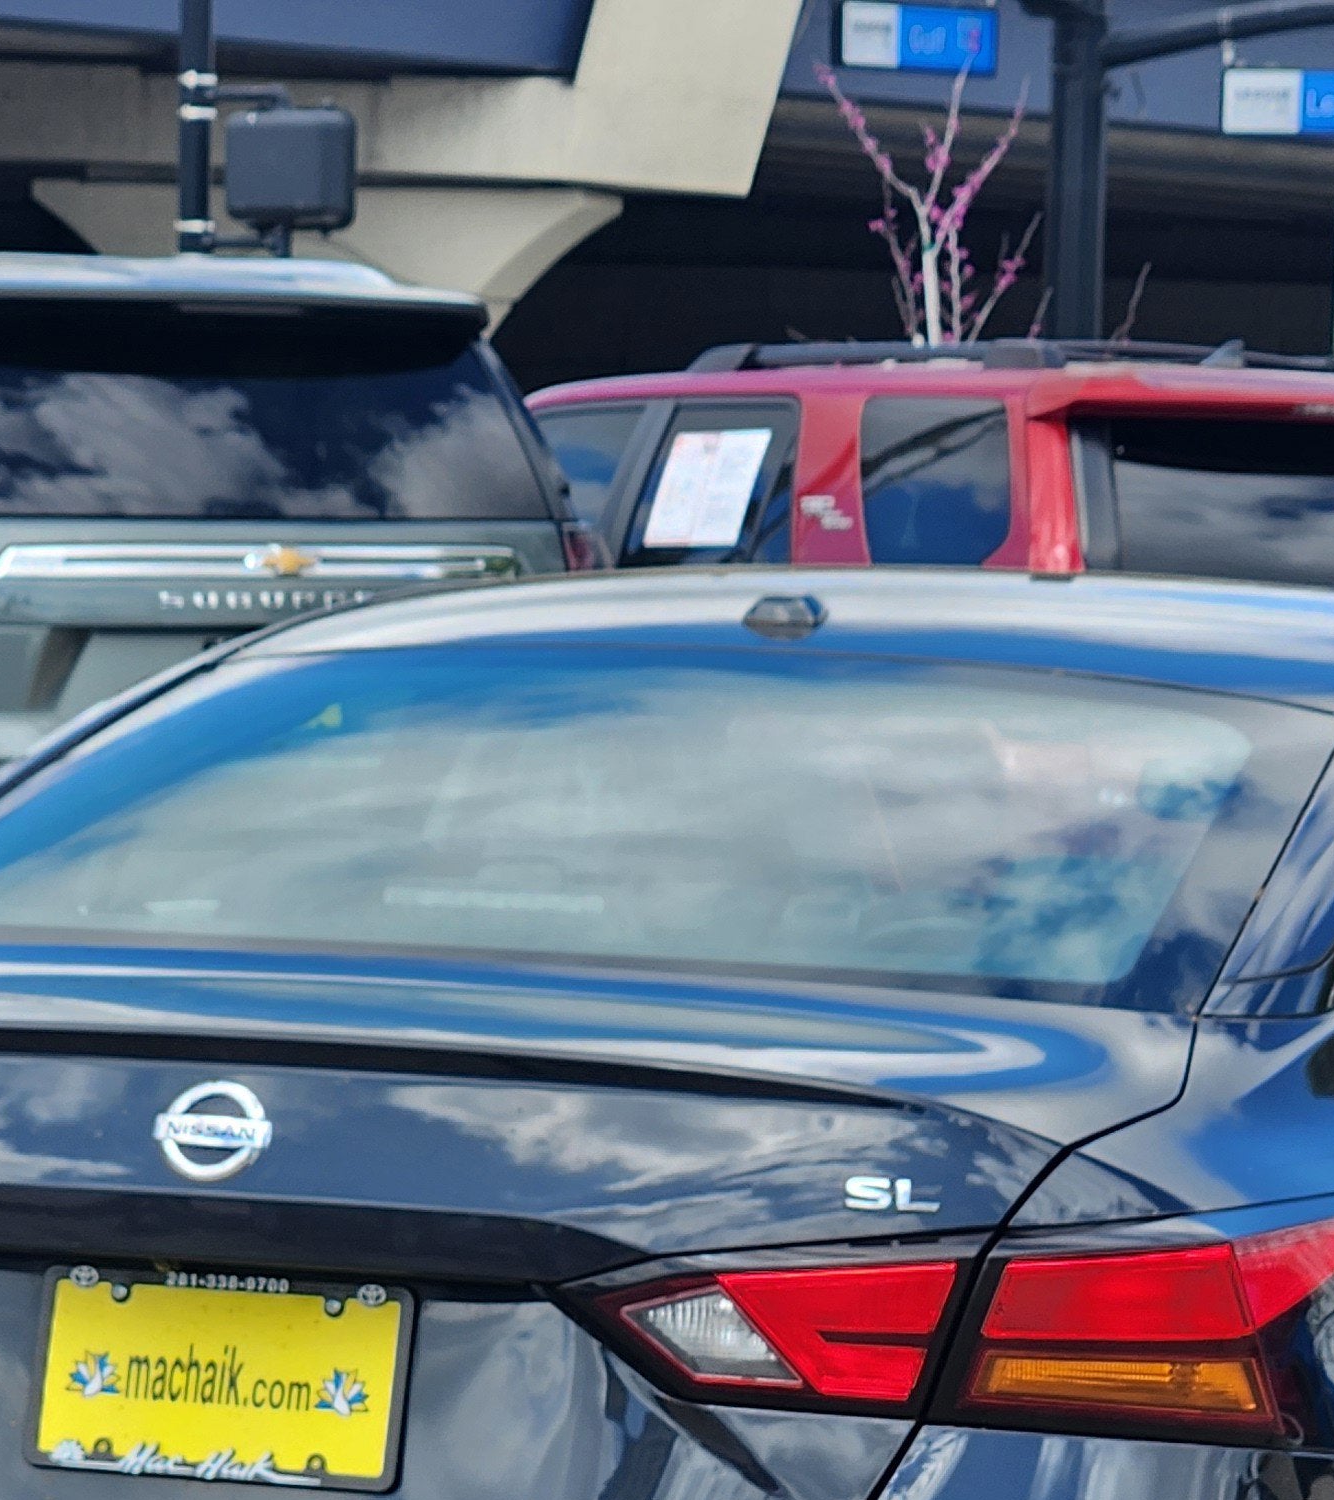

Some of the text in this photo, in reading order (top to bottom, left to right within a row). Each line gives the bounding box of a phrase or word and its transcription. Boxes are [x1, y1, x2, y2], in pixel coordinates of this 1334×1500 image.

[167, 1120, 257, 1142] NISSAN
[844, 1176, 941, 1213] SL
[124, 1343, 312, 1412] machaik.com
